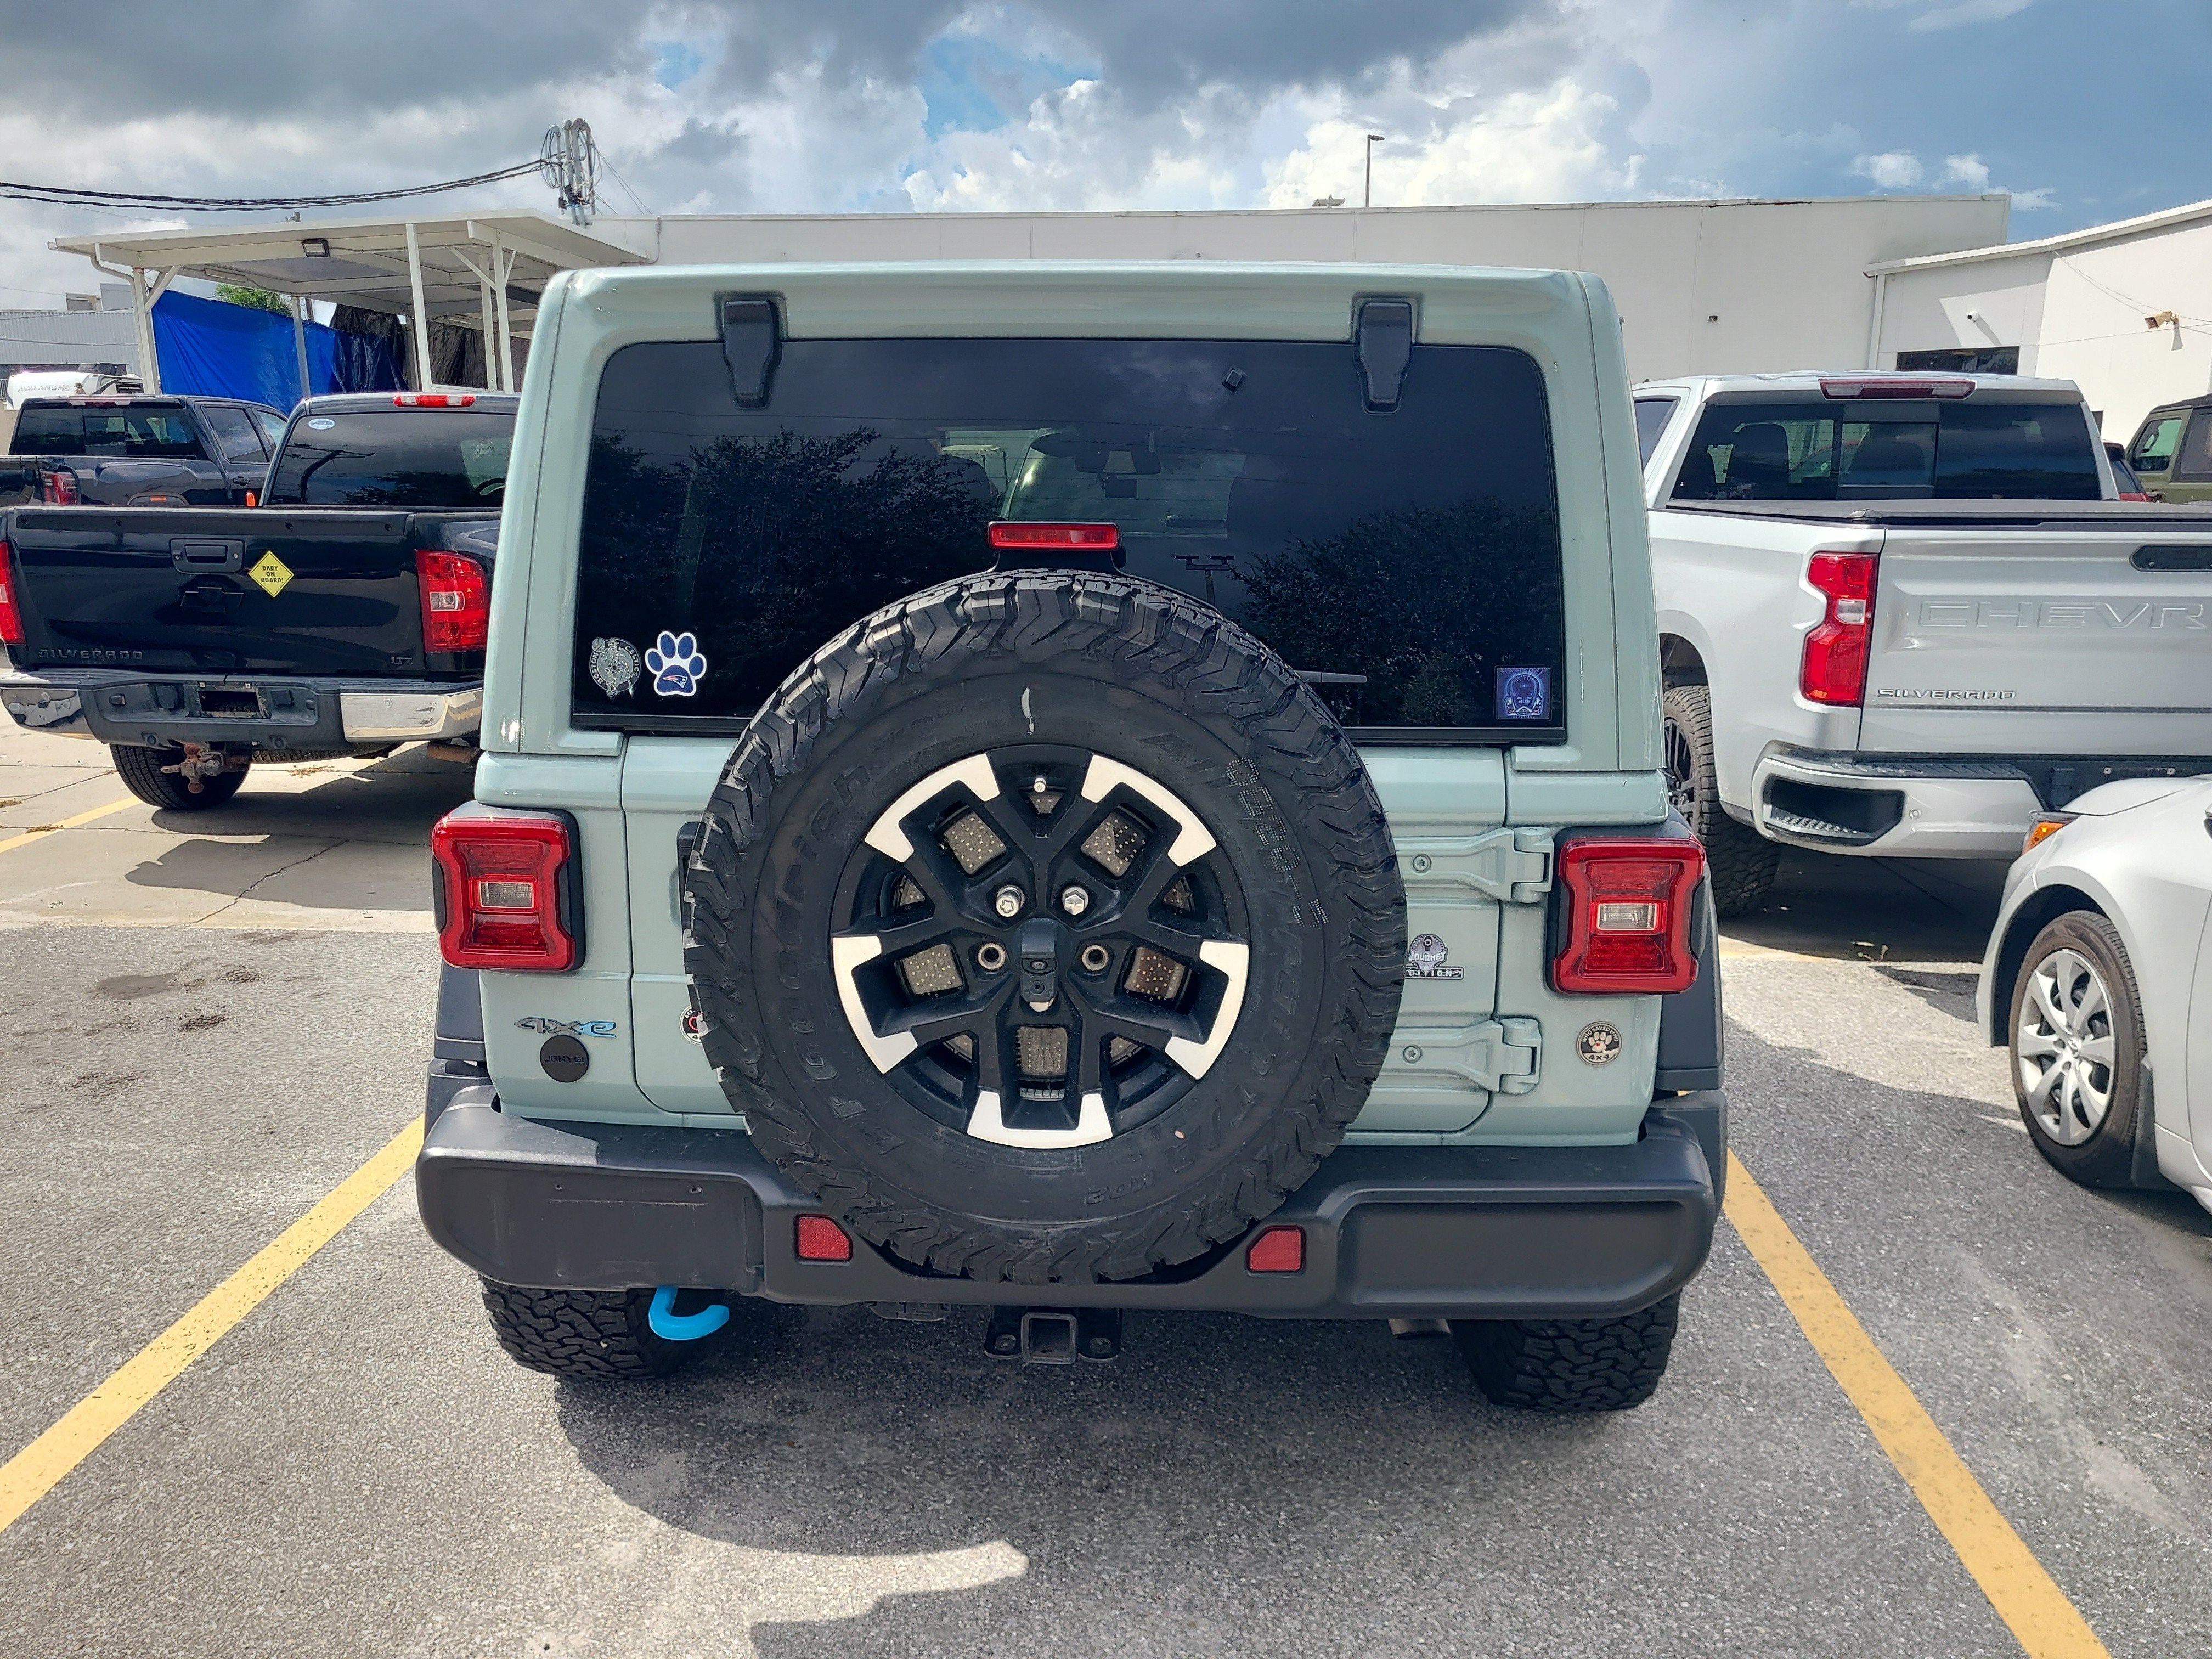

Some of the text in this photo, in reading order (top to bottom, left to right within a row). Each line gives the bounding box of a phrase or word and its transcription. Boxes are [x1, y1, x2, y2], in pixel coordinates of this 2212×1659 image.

[38, 648, 143, 660] SILVERADO
[624, 645, 640, 677] CELTICS
[591, 652, 604, 685] BOSTON
[1877, 687, 2016, 701] SILVERADO
[1408, 950, 1447, 961] JOURNEY
[1582, 1030, 1593, 1042] WHO
[1610, 1029, 1619, 1042] WHO
